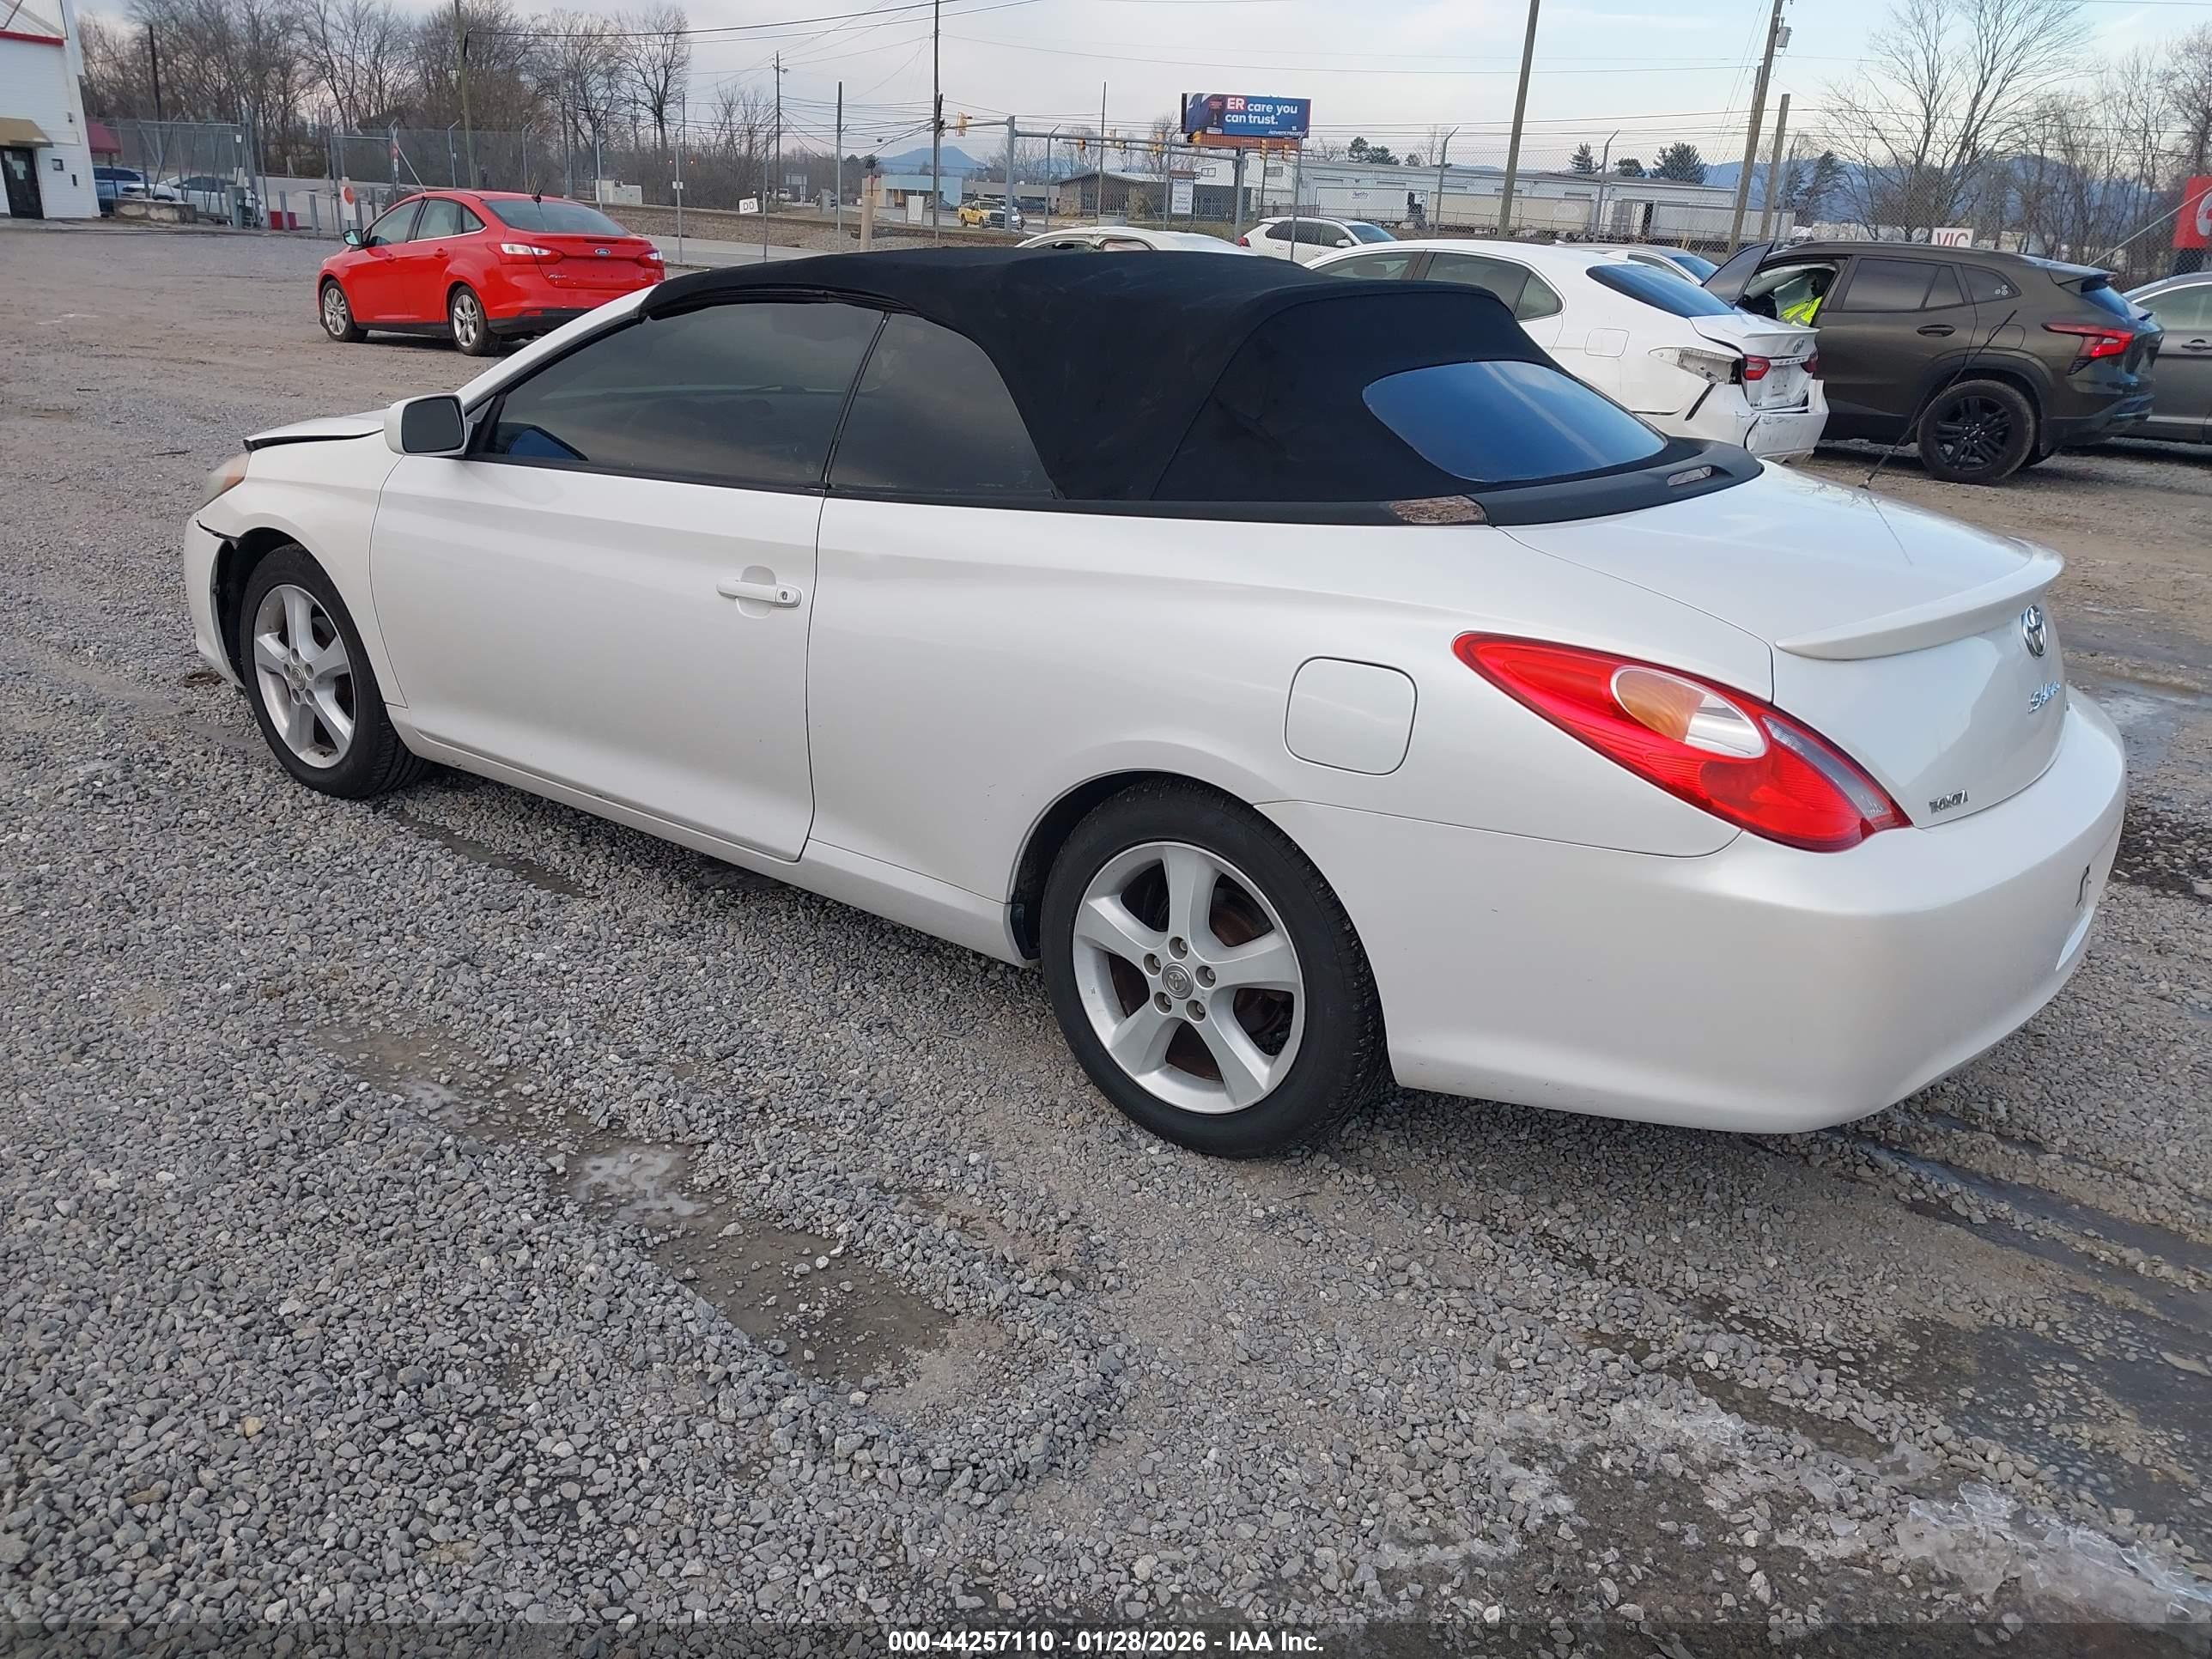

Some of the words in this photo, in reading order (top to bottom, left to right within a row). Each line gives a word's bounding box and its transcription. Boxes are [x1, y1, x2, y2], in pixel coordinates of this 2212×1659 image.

[1226, 97, 1245, 110] ER
[1247, 103, 1273, 112] care
[1276, 104, 1298, 115] you
[1224, 113, 1247, 123] can
[1248, 114, 1279, 125] trust.
